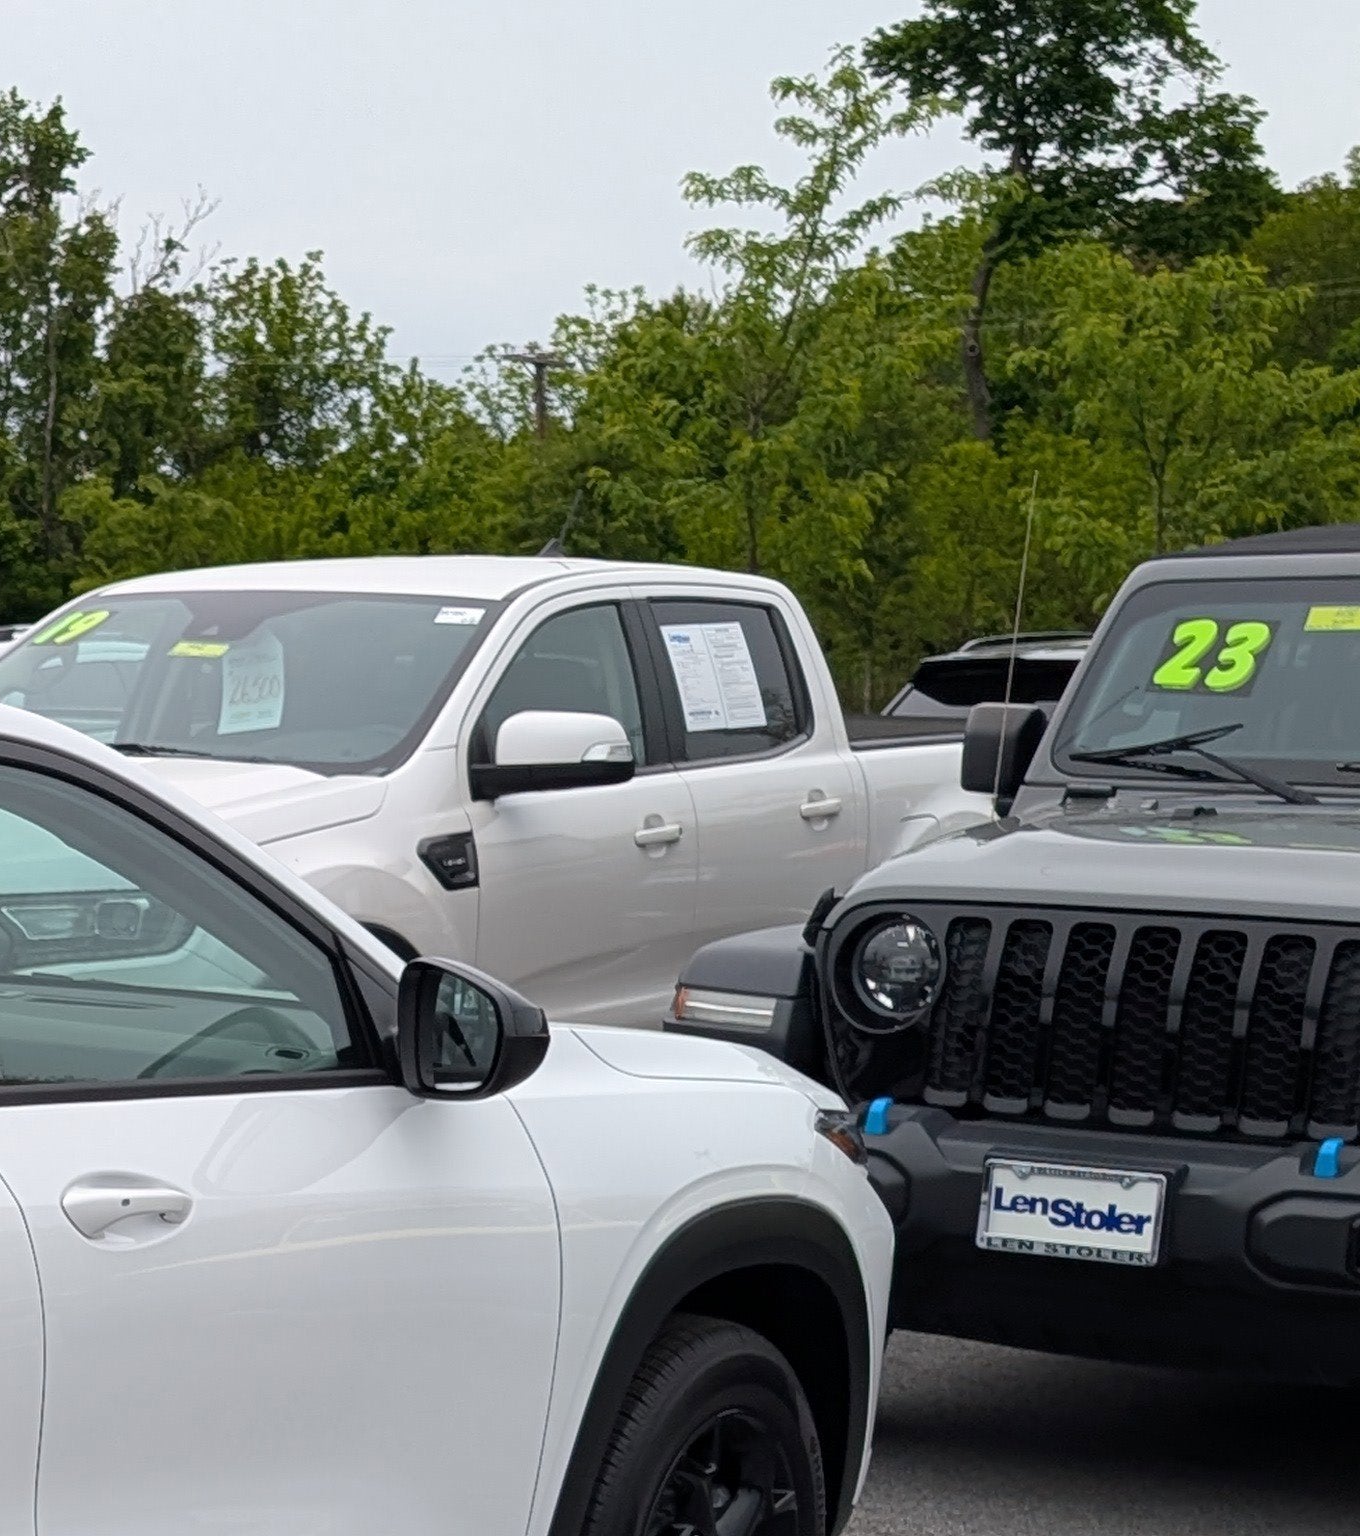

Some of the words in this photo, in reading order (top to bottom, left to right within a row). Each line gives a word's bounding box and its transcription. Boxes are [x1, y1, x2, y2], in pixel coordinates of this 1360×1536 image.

[1152, 618, 1272, 693] 23
[985, 1238, 1035, 1251] LEN
[1044, 1242, 1151, 1264] STOLER
